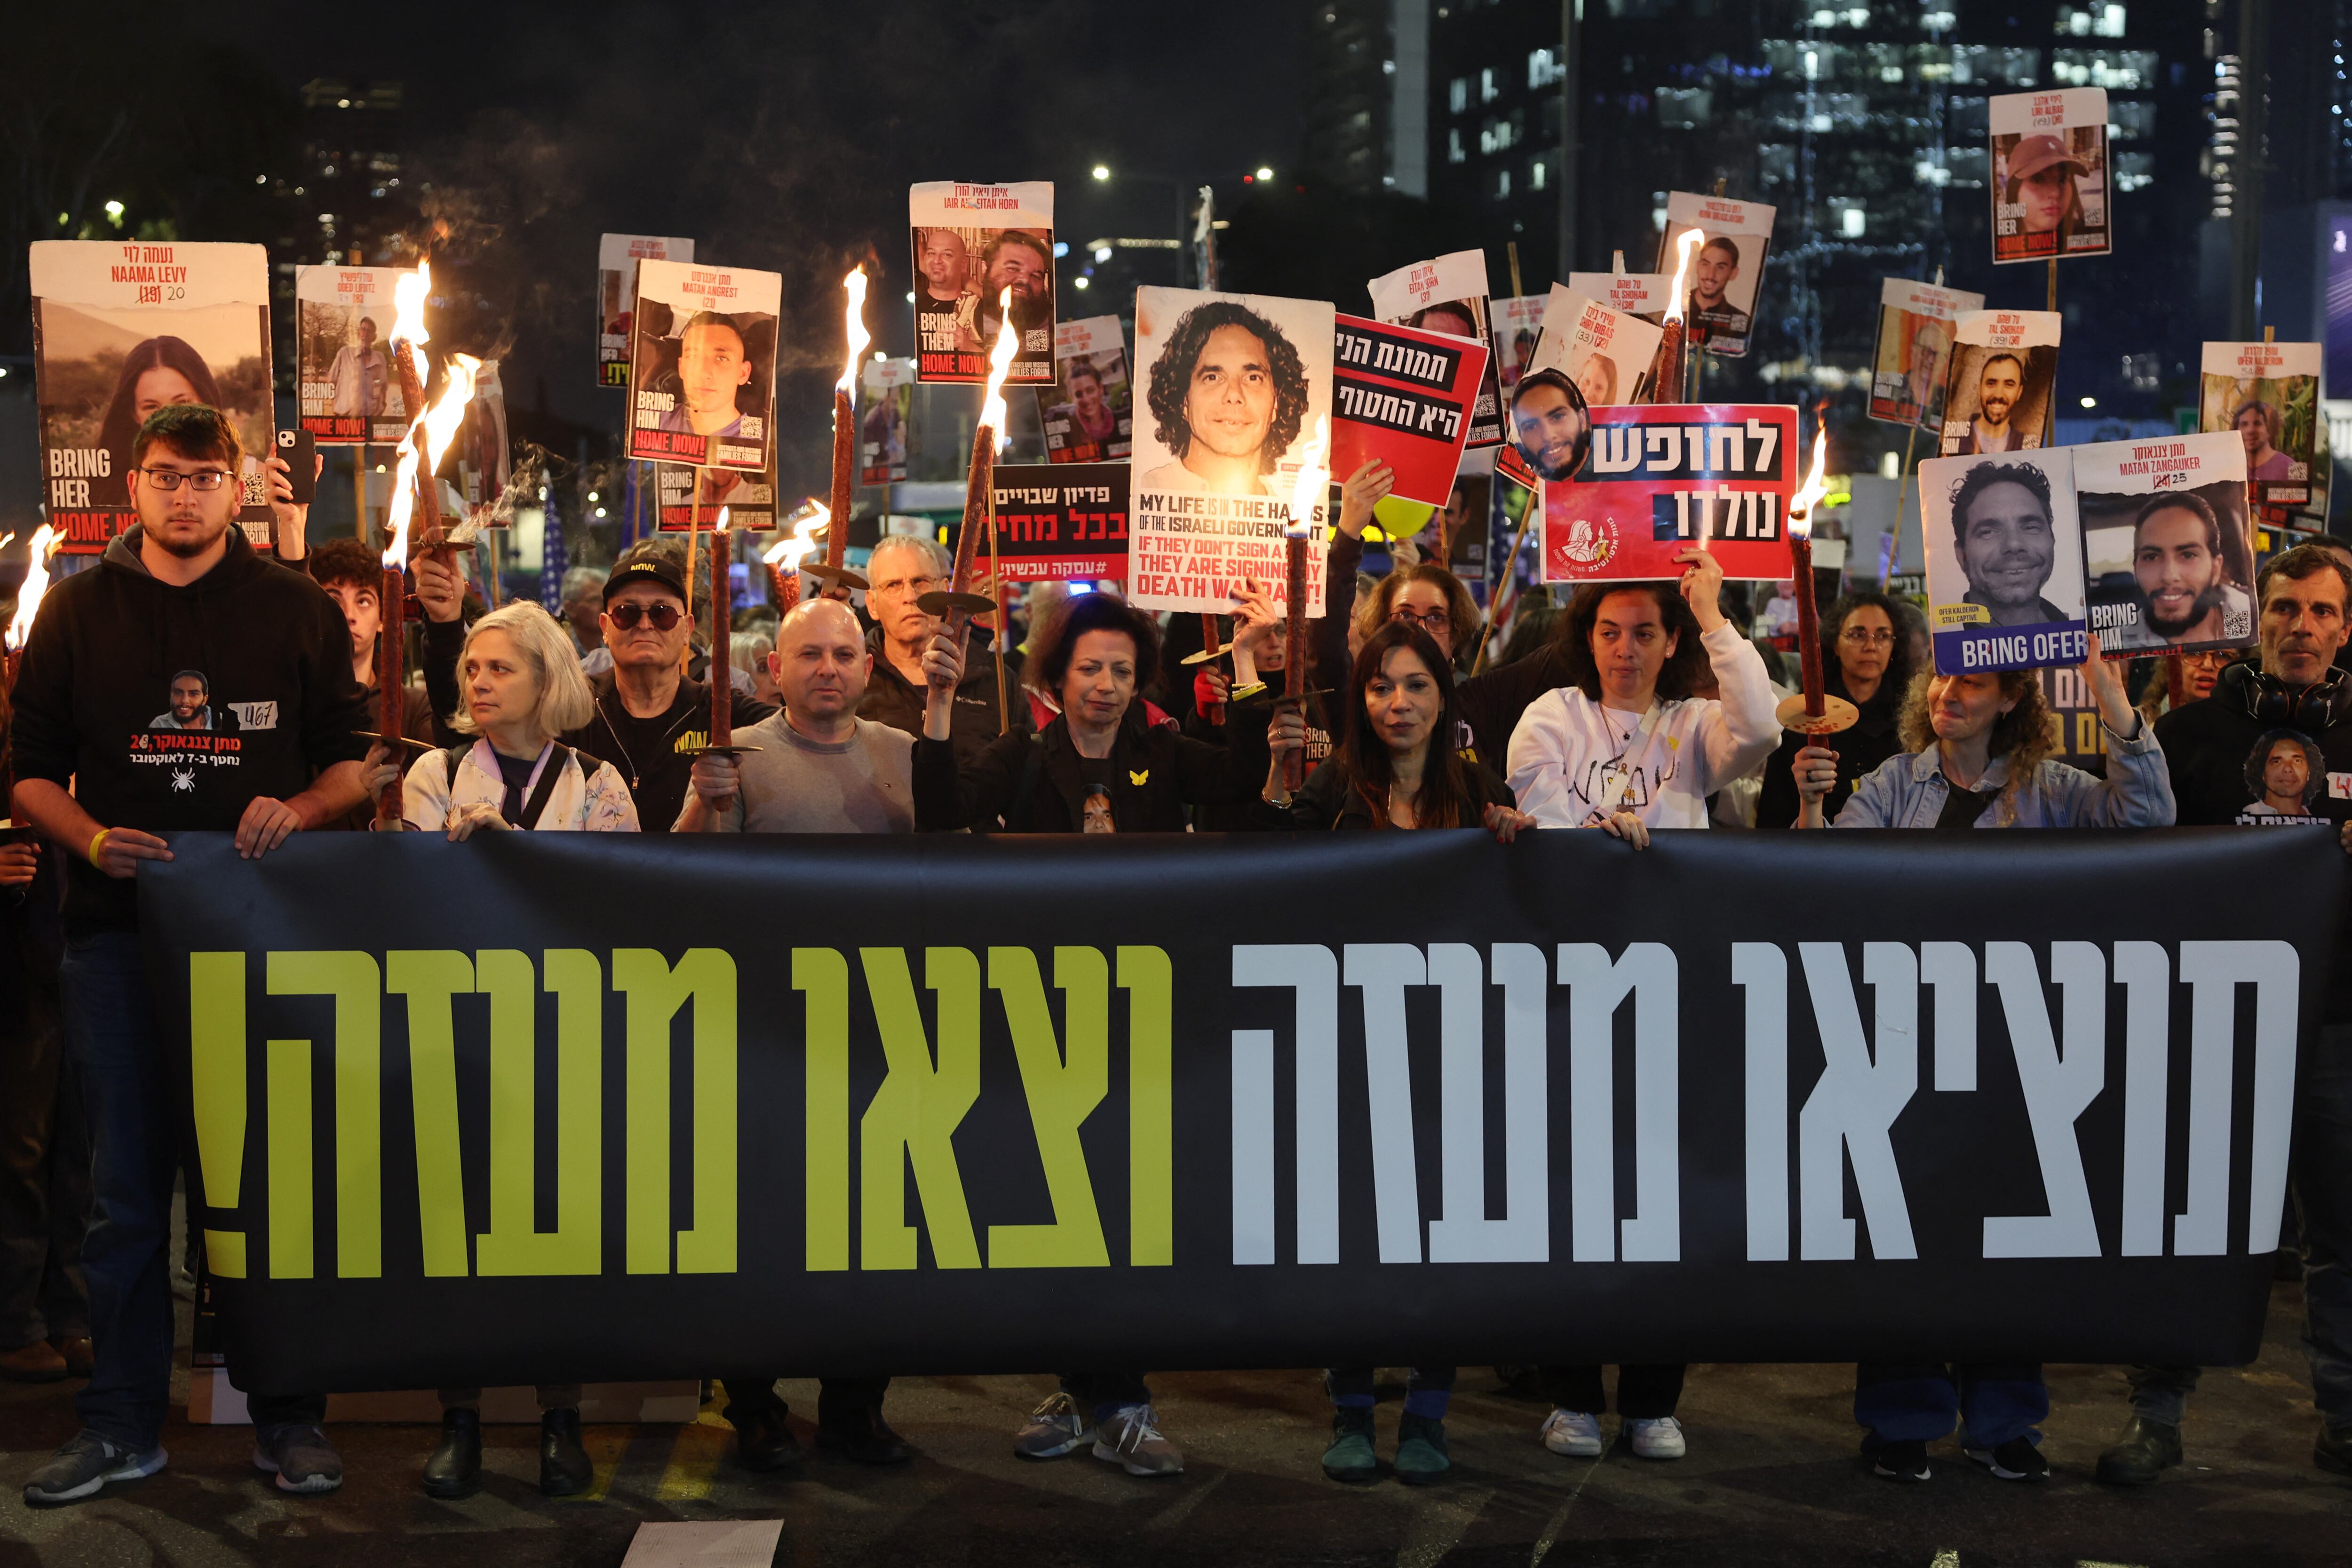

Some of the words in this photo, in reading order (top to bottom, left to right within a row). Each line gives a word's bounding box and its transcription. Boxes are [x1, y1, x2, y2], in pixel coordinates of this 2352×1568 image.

[955, 185, 969, 197] הורן
[992, 188, 1008, 198] איתן
[944, 197, 958, 208] IAIR
[999, 198, 1018, 210] HORN
[1997, 203, 2027, 219] BRING
[1997, 219, 2017, 235] HER
[1998, 236, 2026, 253] HOME
[123, 245, 140, 263] לוי
[143, 247, 173, 263] נעמה
[111, 266, 155, 282] NAAMA
[159, 267, 187, 283] LEVY
[718, 274, 731, 285] מתן
[140, 285, 161, 304] (19)
[167, 286, 185, 301] 20
[683, 282, 706, 295] MATAN
[707, 285, 738, 298] ANGREST
[1409, 281, 1424, 294] EITAN
[1610, 290, 1620, 299] TAL
[1621, 290, 1648, 300] SHOHAM
[703, 296, 715, 309] (21)
[1621, 301, 1634, 310] (38)
[921, 313, 957, 332] BRING
[1600, 311, 1615, 326] שירי
[1580, 316, 1594, 331] SHIRI
[1594, 323, 1614, 339] BIBAS
[921, 332, 954, 351] THEM
[1576, 329, 1594, 345] (33)
[922, 354, 955, 372] HOME
[1374, 341, 1448, 383] תמונת
[1008, 368, 1029, 377] AMILIES
[1030, 368, 1050, 377] FORUM
[302, 382, 335, 399] BRING
[302, 399, 323, 416] HIM
[637, 390, 675, 412] BRING
[1339, 386, 1416, 427] החטוף
[302, 418, 333, 435] HOME
[335, 417, 366, 436] NOW!
[636, 409, 660, 430] HIM
[1419, 404, 1462, 437] היא
[1481, 430, 1501, 441] FORUM
[1944, 421, 1971, 437] BRING
[636, 430, 669, 451] HOME
[672, 434, 706, 456] NOW!
[1592, 418, 1778, 473] לחופש
[1942, 437, 1960, 454] HIM
[2169, 443, 2185, 458] מתן
[717, 451, 741, 461] FAMILIES
[741, 452, 761, 462] FORUM
[2132, 445, 2167, 461] צנגאוקר
[50, 448, 111, 478] BRING
[2120, 461, 2149, 476] MATAN
[2151, 457, 2201, 473] ZANGAUKER
[661, 472, 692, 488] BRING
[2172, 473, 2187, 483] 25
[51, 479, 91, 508] HER
[662, 489, 681, 505] HIM
[994, 488, 1058, 505] שבויים
[1064, 487, 1110, 506] פדיון
[662, 507, 691, 523] HOME
[1140, 494, 1164, 512] MY
[1168, 496, 1204, 514] LIFE
[1208, 498, 1217, 515] IS
[1220, 499, 1229, 516] IN
[1233, 500, 1264, 518] THE
[1269, 502, 1323, 522] HAS
[1674, 484, 1775, 538] נולדו
[54, 512, 111, 541] HOME
[241, 521, 269, 532] MISSING
[996, 515, 1057, 541] מחי
[1069, 508, 1128, 540] בכל
[1139, 515, 1150, 530] OF
[1152, 515, 1166, 531] THE
[1169, 517, 1224, 534] ISRAELI
[1227, 521, 1322, 540] GOVERNNT
[1139, 536, 1152, 551] IF
[1155, 537, 1191, 553] THEY
[1194, 539, 1234, 556] DON'T
[1237, 542, 1269, 558] SIGN
[1271, 544, 1282, 559] A
[1052, 561, 1107, 577] #עסקה
[1138, 554, 1183, 573] THEY
[1186, 557, 1222, 575] ARE
[1226, 559, 1288, 579] SIGNING
[1137, 574, 1206, 598] DEATH
[1953, 605, 1979, 614] KALDERON
[2091, 602, 2137, 628] BRING
[2093, 627, 2123, 651] HIM
[1962, 635, 2028, 668] BRING
[2034, 630, 2089, 661] OFER
[961, 697, 986, 705] Columbia
[245, 702, 273, 726] 467
[1306, 727, 1330, 744] BRIN
[215, 736, 241, 753] מתן
[1306, 743, 1333, 760] THEM
[129, 752, 185, 765] לאוקטובר
[188, 753, 207, 764] ב-7
[210, 755, 239, 766] נחטף
[792, 945, 1173, 1271] וצאו
[1232, 942, 1680, 1265] מעזה
[1732, 941, 2300, 1261] תוציאו
[190, 948, 737, 1279] מעזה!
